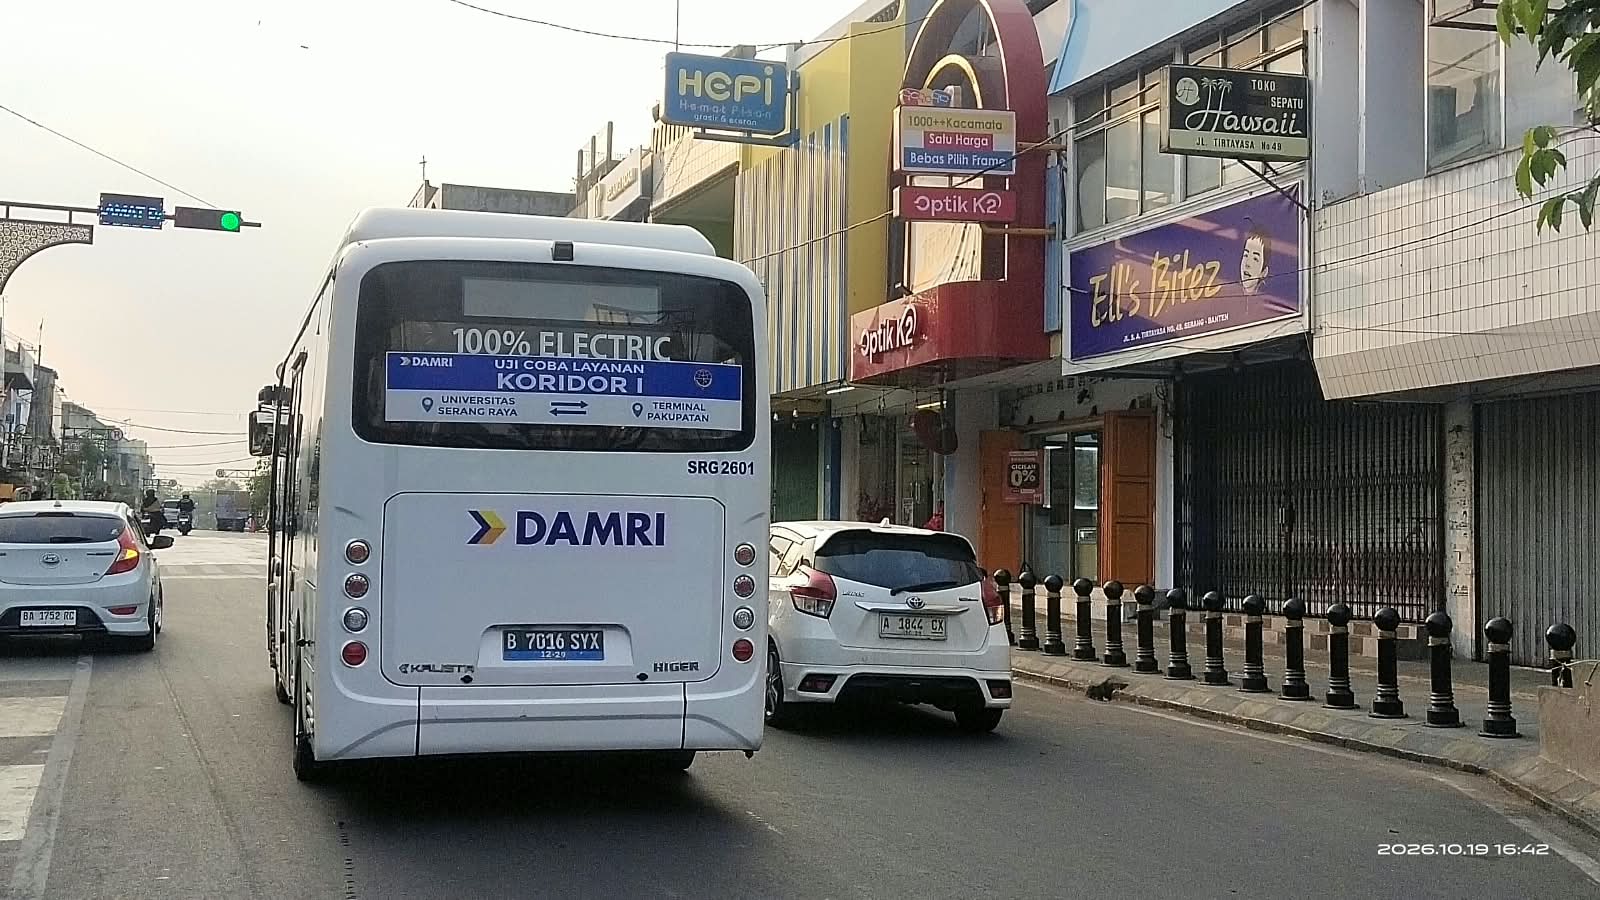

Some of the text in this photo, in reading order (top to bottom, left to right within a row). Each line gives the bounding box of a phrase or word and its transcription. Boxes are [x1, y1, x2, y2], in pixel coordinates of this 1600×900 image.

[1250, 79, 1276, 92] TOKO
[1184, 76, 1303, 135] Hawaii
[1270, 96, 1304, 110] SEPATU
[929, 132, 989, 149] Satu Harga
[1196, 136, 1208, 146] JL.
[1213, 137, 1255, 150] TIRTAYASA
[1271, 141, 1282, 151] 49
[910, 151, 1006, 168] Bebas Pilih Frame
[914, 192, 1002, 217] Optik K2
[1089, 248, 1222, 328] Ell's Bitez
[1141, 327, 1166, 338] TIRTAYASA
[1184, 318, 1205, 329] SERANG
[1207, 312, 1229, 324] BANTEN
[860, 304, 917, 364] Optik K2
[453, 328, 671, 361] 100% ELECTRIC
[412, 356, 453, 367] DAMRI
[494, 359, 644, 373] UJI COBA LAYANAN
[497, 372, 643, 393] KORIDOR I
[441, 395, 515, 405] UNIVERSITAS
[653, 402, 706, 411] TERMINAL
[438, 407, 518, 416] SERANG RAYA
[647, 412, 709, 422] PAKUPATAN
[1010, 470, 1036, 487] 0%
[515, 510, 665, 546] DAMRI
[23, 611, 75, 621] BA 1752 RC
[883, 617, 944, 632] A 1844 CX
[507, 633, 600, 650] B 7016 SYX
[411, 664, 475, 674] KALISTA
[653, 662, 700, 673] HIGER
